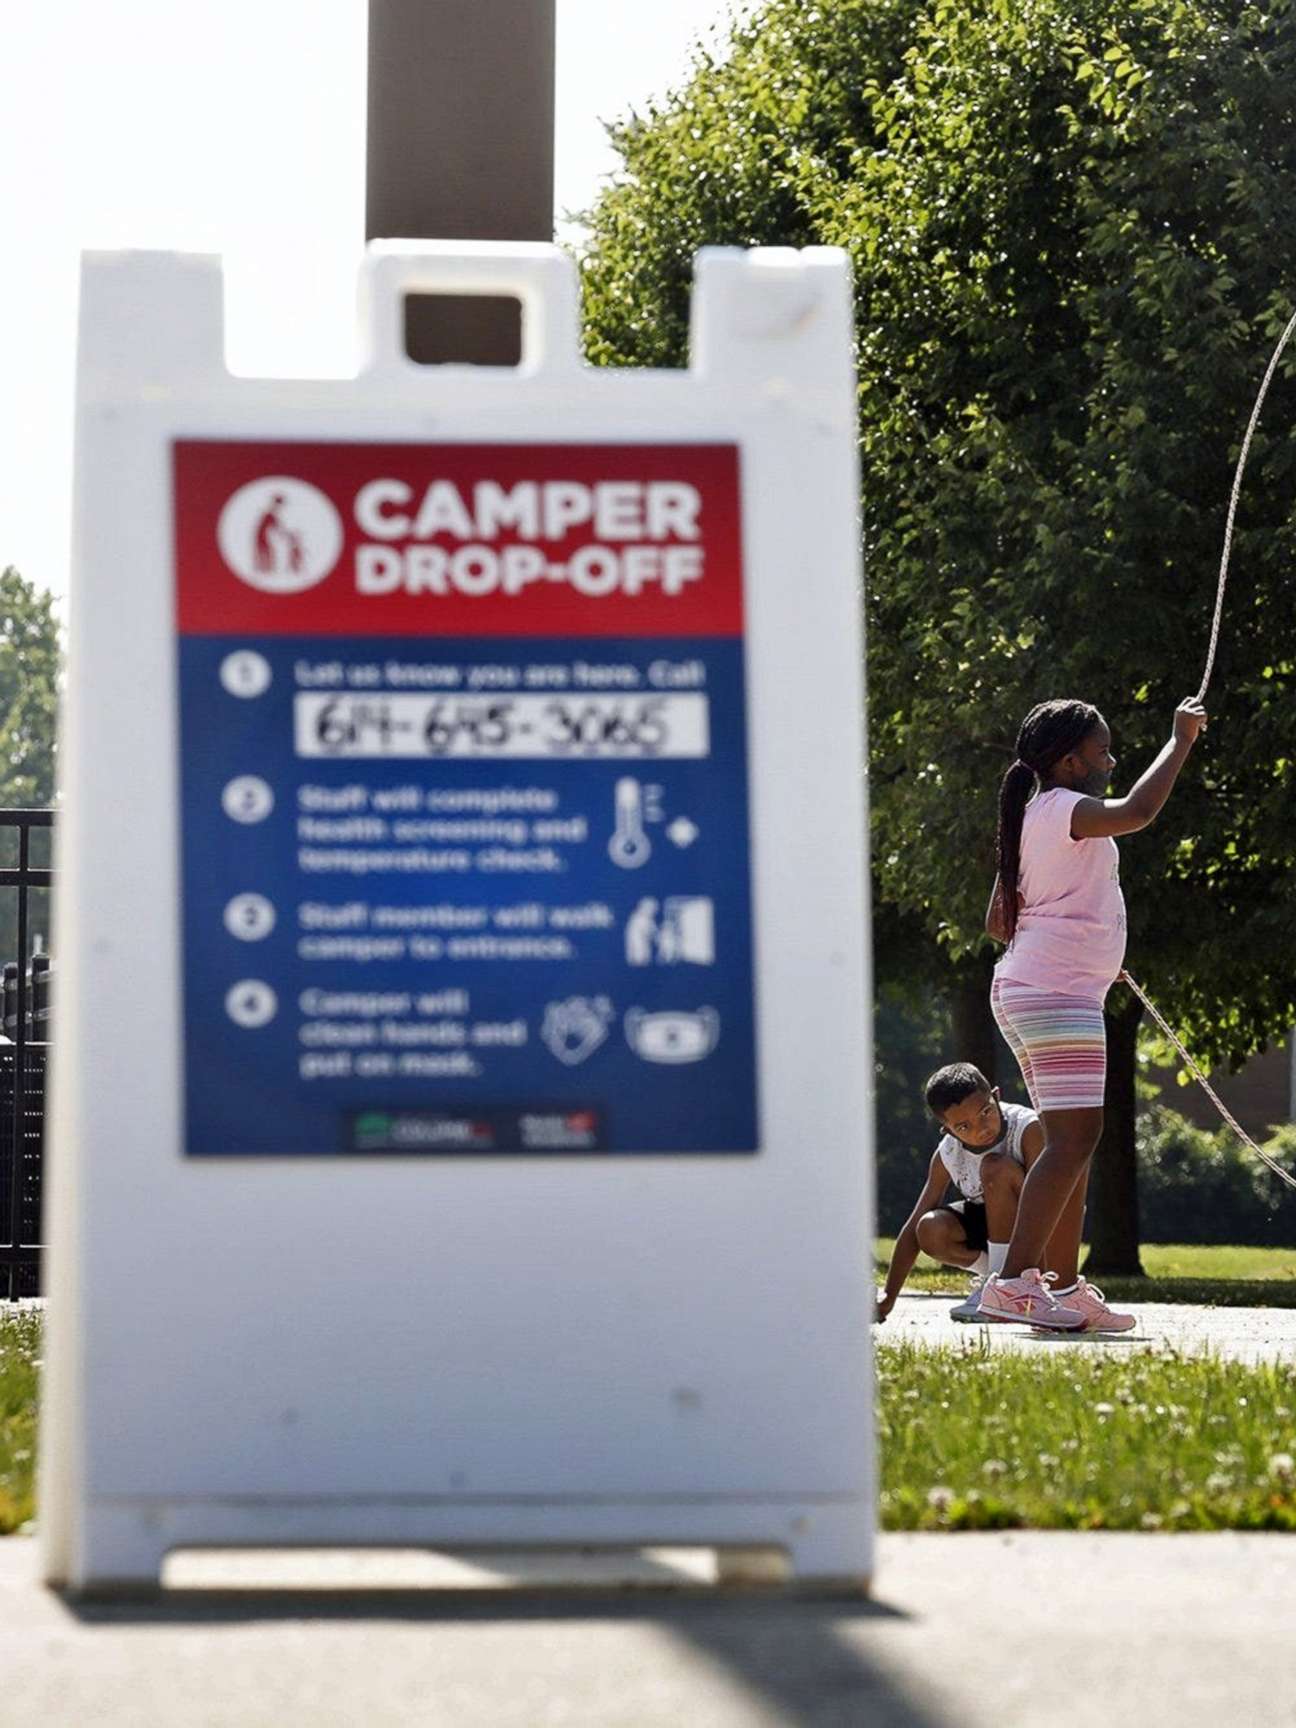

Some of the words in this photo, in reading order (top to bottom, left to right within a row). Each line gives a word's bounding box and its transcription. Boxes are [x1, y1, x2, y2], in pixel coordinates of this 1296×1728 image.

[354, 478, 702, 541] CAMPER
[354, 545, 704, 596] DROP-OFF
[296, 662, 344, 686] Let
[348, 666, 381, 686] us
[385, 663, 461, 686] know
[467, 666, 521, 692] you
[525, 666, 569, 687] are
[648, 661, 705, 687] Call
[299, 785, 368, 811] Staff
[372, 788, 422, 811] will
[428, 789, 556, 816] complete
[298, 818, 387, 841] health
[393, 819, 529, 846] screening
[532, 817, 587, 841] and
[298, 850, 470, 875] temperature
[299, 903, 368, 929] Staff
[372, 906, 487, 928] member
[493, 904, 545, 928] will
[549, 903, 614, 929] walk
[299, 937, 405, 963] camper
[410, 936, 442, 960] to
[300, 988, 411, 1019] Camper
[417, 988, 468, 1016] will
[300, 1022, 377, 1046] clean
[381, 1021, 466, 1046] hands
[471, 1020, 527, 1045] and
[300, 1052, 351, 1080] put
[354, 1055, 394, 1076] on
